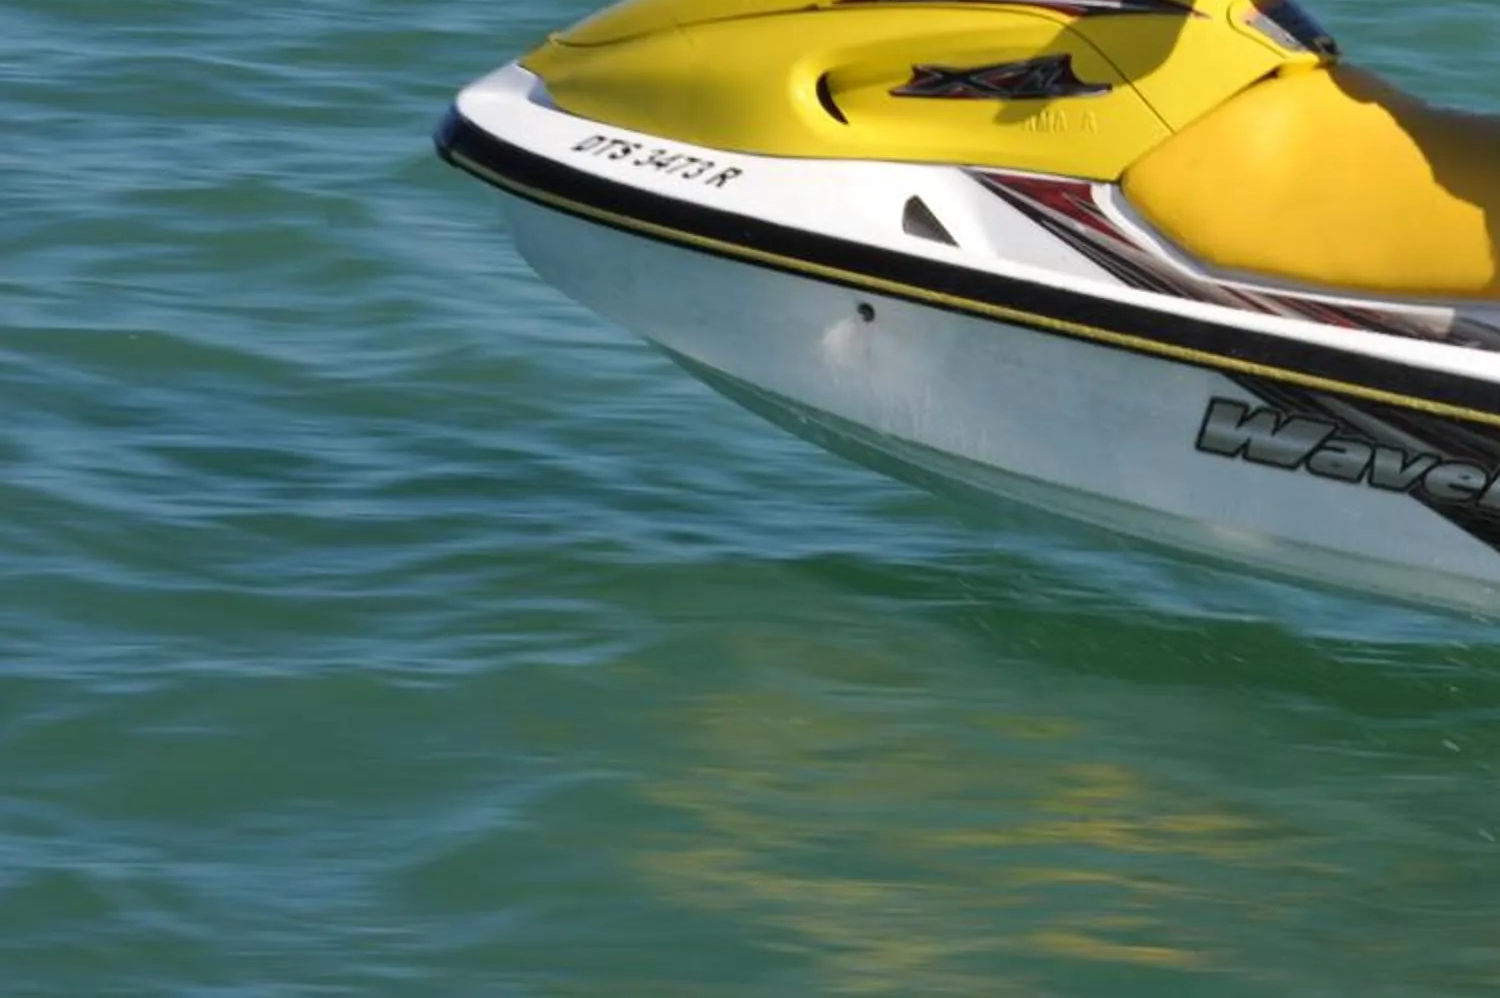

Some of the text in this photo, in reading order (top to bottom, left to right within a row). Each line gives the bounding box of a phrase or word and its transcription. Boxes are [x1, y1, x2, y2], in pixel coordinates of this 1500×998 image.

[1012, 107, 1098, 139] AMAA
[571, 135, 744, 189] DTS 3473 R
